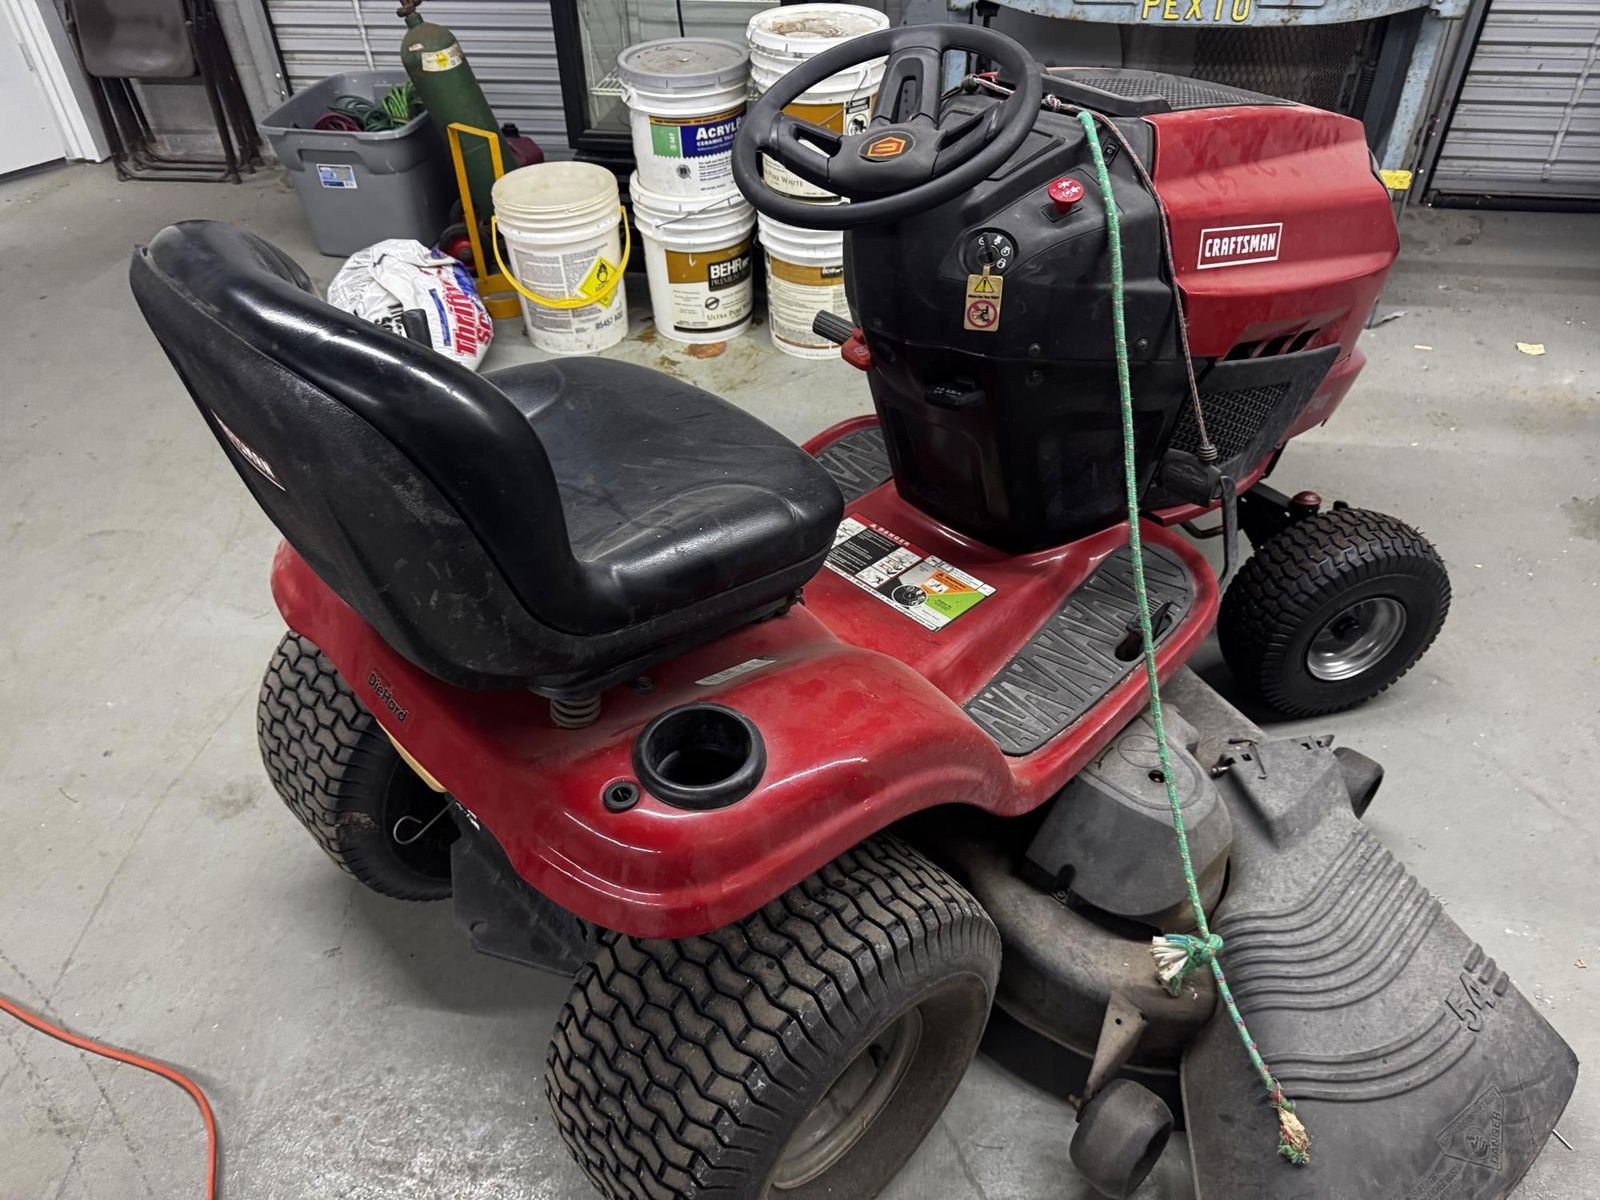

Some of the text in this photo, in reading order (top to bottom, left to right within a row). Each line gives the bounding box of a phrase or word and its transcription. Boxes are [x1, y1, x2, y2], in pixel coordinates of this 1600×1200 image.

[1205, 233, 1276, 257] CRAFTSMAN
[710, 258, 741, 279] BEHR
[878, 526, 911, 547] DANGER
[369, 672, 408, 721] DieHard
[1490, 1111, 1501, 1165] DANGER
